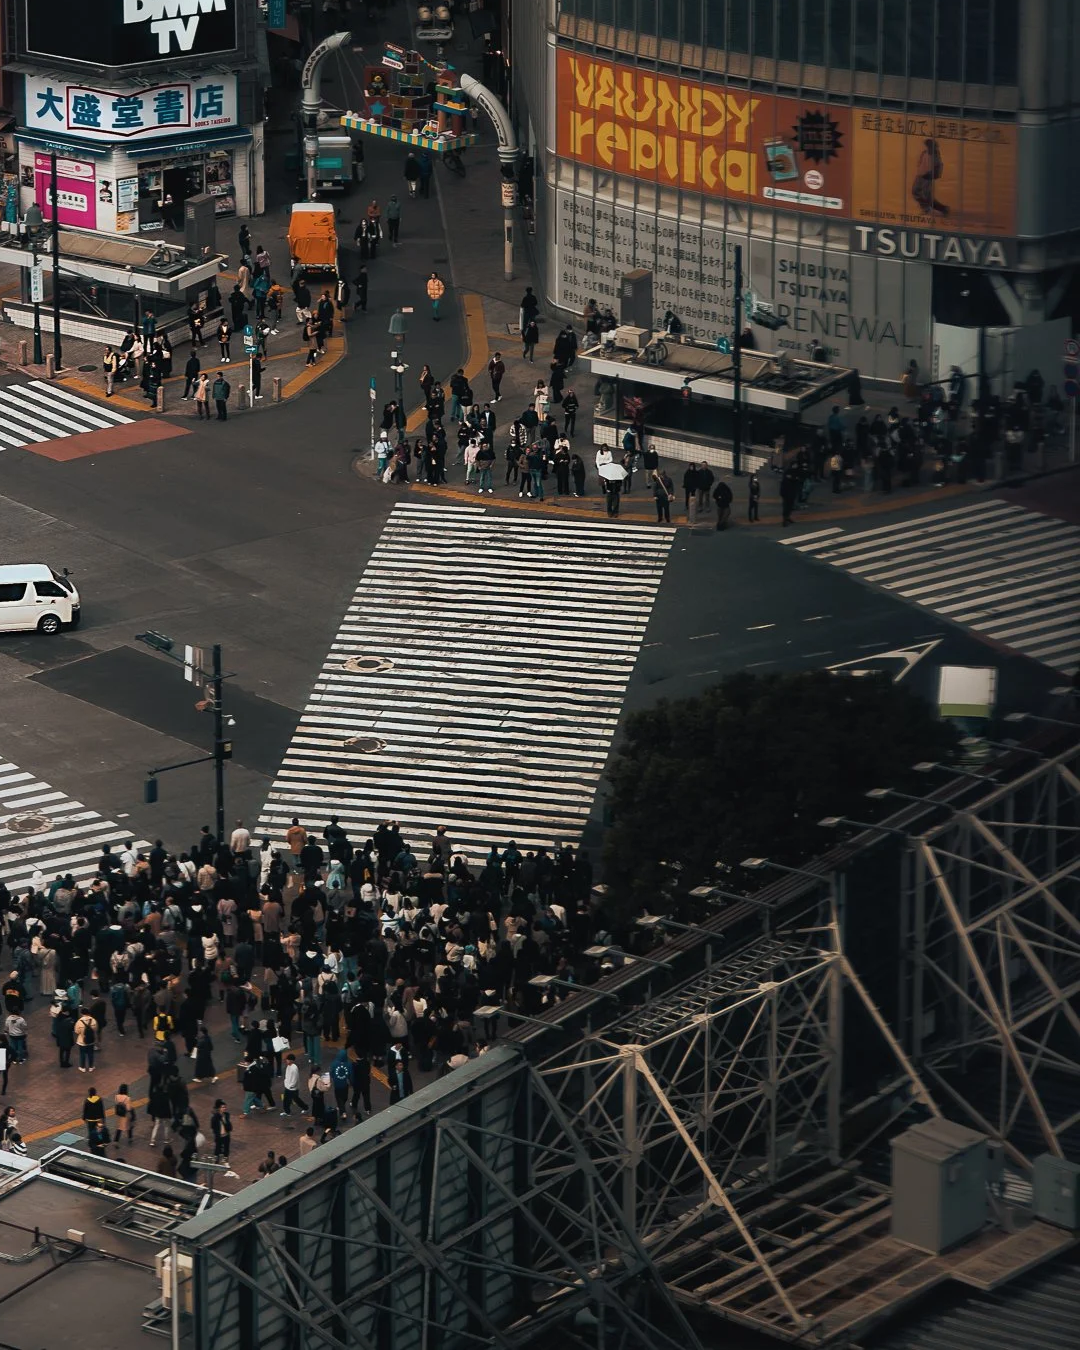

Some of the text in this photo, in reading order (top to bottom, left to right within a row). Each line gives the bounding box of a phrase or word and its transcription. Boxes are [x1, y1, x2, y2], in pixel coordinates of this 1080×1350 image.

[150, 15, 200, 55] TV
[36, 84, 224, 129] 大盛堂書店
[855, 225, 1007, 267] TSUTAYA
[778, 258, 849, 281] SHIBUYA
[777, 280, 849, 304] TSUTAYA
